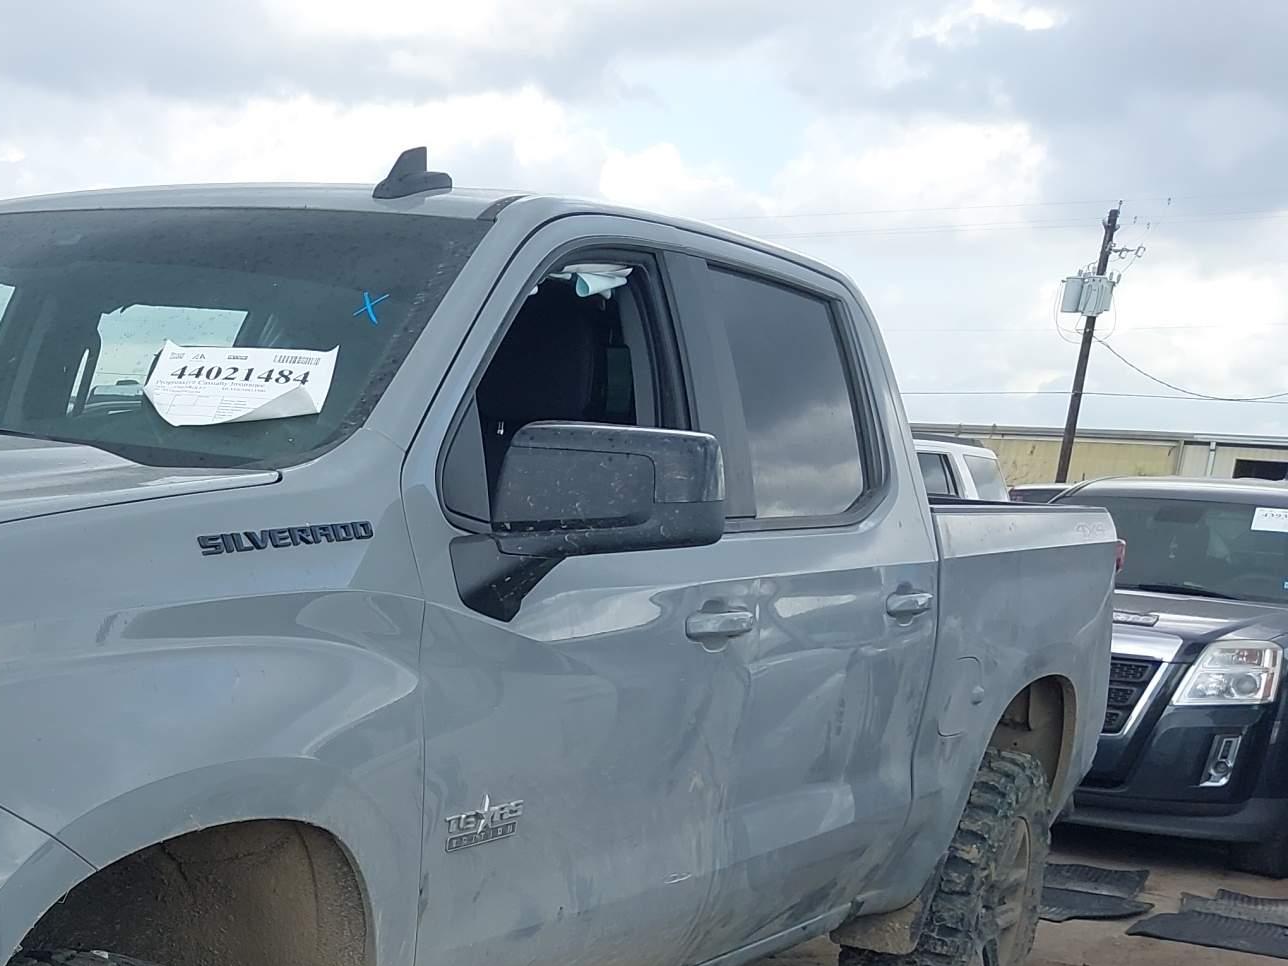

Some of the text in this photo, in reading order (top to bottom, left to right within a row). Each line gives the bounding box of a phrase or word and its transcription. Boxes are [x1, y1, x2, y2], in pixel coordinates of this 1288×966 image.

[170, 365, 310, 386] 44021484
[197, 520, 374, 556] SILVERADO
[445, 794, 524, 833] TEXAS
[452, 823, 514, 848] EDITION
